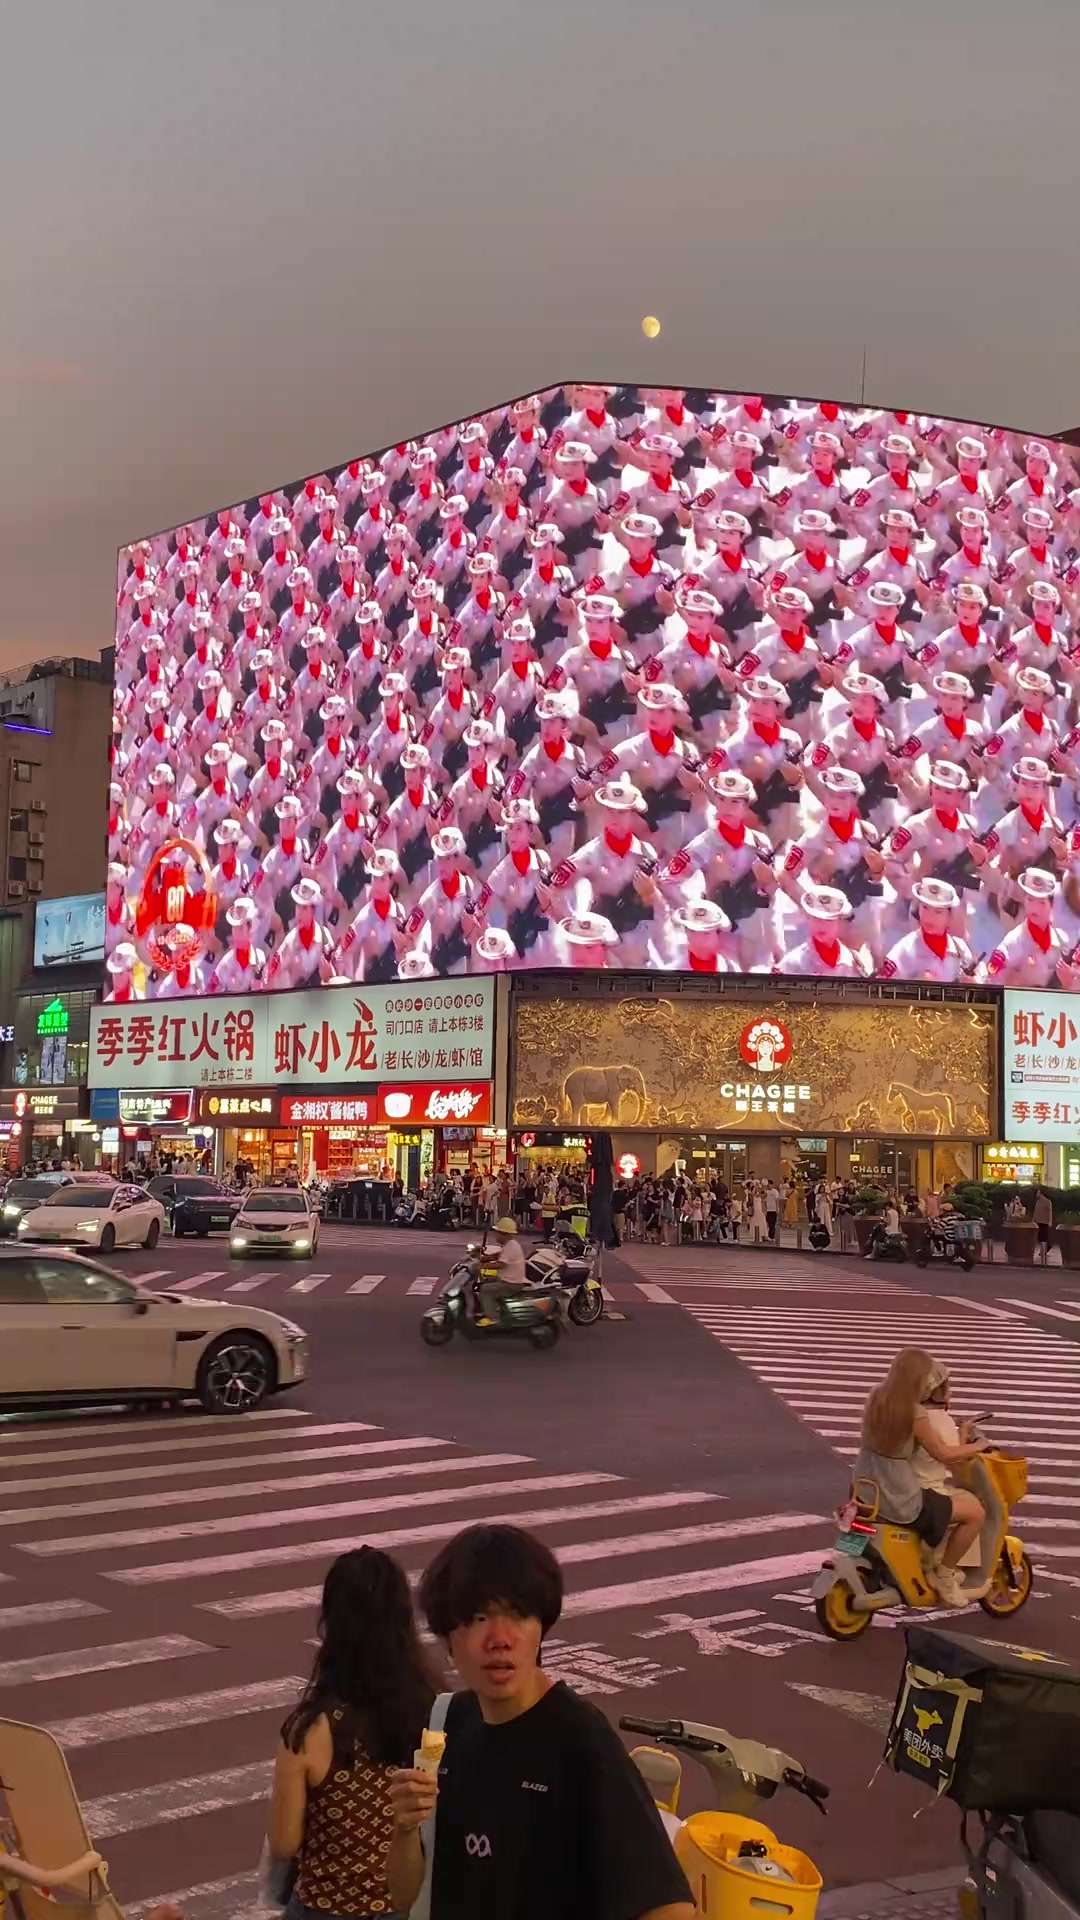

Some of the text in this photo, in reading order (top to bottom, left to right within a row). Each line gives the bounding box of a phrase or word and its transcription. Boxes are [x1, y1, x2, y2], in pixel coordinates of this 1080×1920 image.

[385, 1015, 484, 1036] 司门口店 请上本栋3楼
[97, 1009, 255, 1067] 季季红火锅
[274, 998, 378, 1074] 虾小龙
[200, 1067, 253, 1083] 请上本栋二楼
[31, 1096, 58, 1105] CHAGEE
[720, 1083, 811, 1100] CHAGEE
[852, 1165, 893, 1174] CHAGEE
[903, 1728, 944, 1762] 美团外卖
